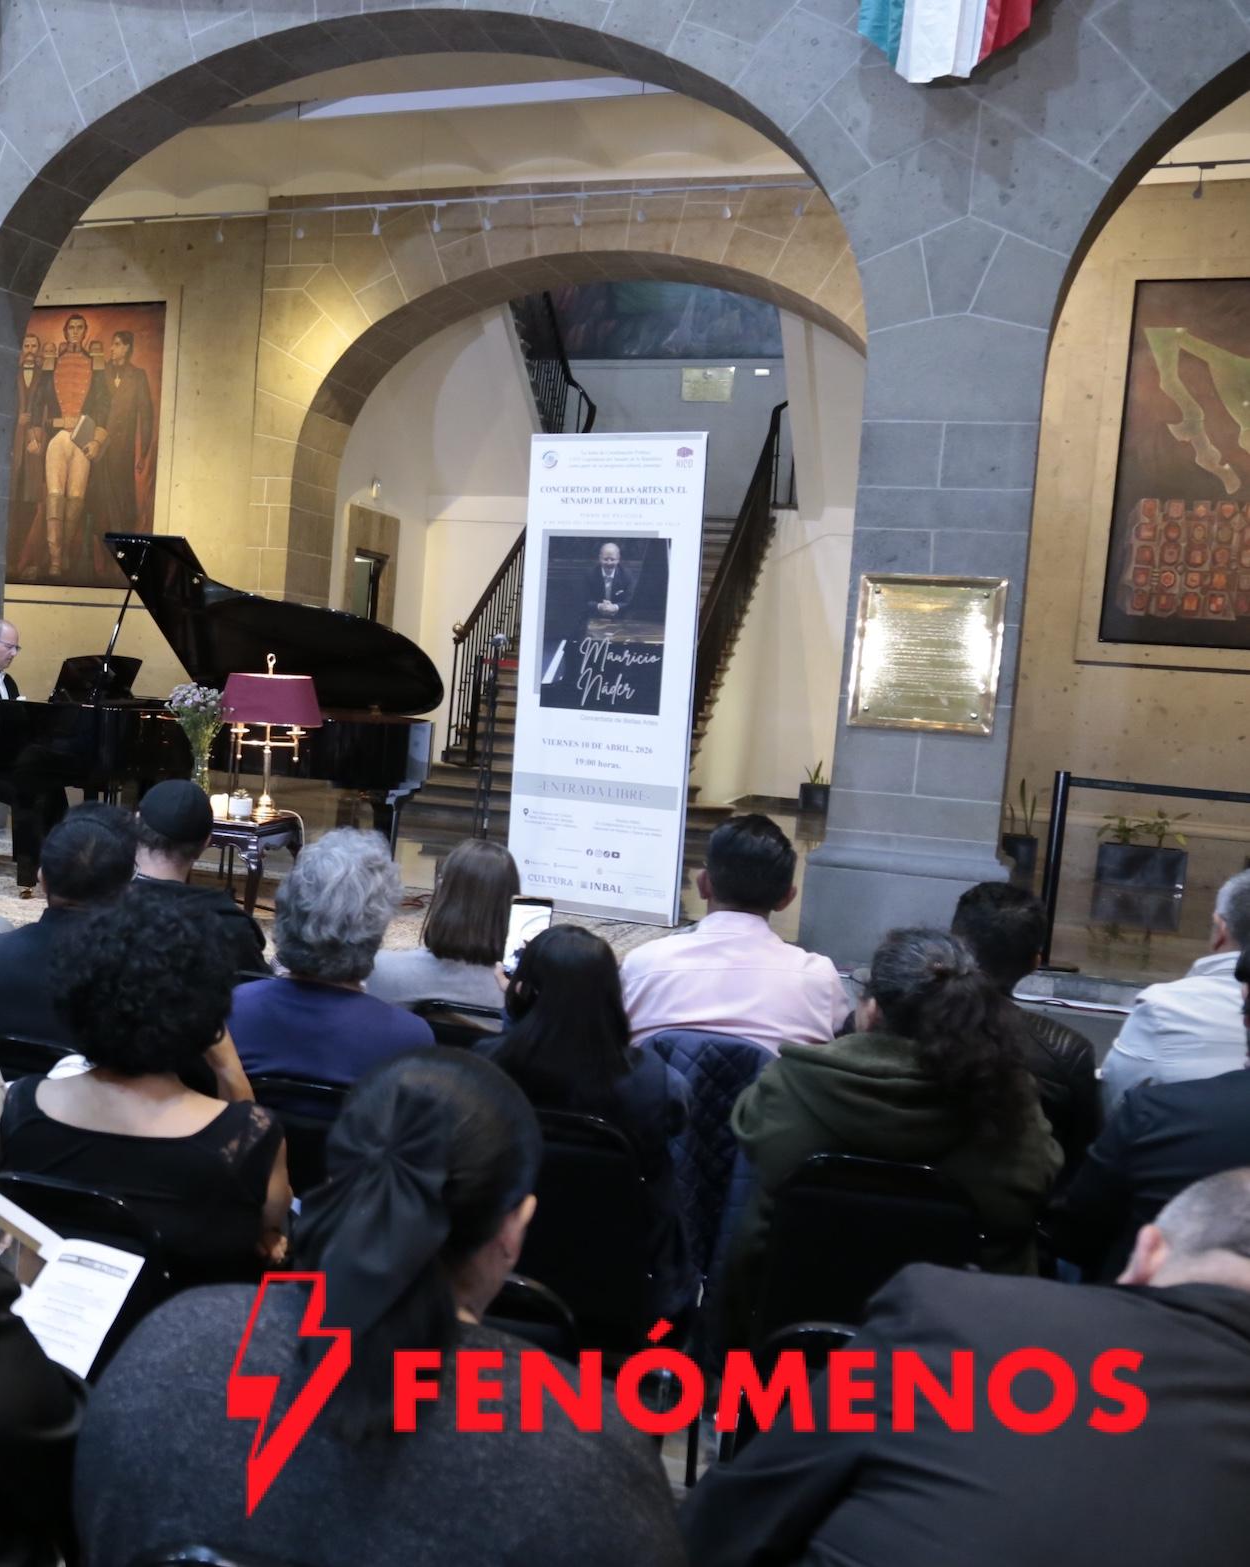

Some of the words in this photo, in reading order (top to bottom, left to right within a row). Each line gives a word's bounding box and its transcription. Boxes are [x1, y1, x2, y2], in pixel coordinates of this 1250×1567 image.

[540, 486, 591, 494] CONCIERTOS
[592, 486, 602, 494] DE
[604, 486, 635, 494] BELLAS
[637, 486, 663, 494] ARTES
[664, 486, 675, 494] EN
[677, 486, 688, 494] EL
[560, 497, 593, 505] SENADO
[594, 497, 603, 505] DE
[606, 497, 617, 505] LA
[618, 496, 665, 506] REPÚBLICA
[579, 637, 661, 674] Mauricio
[577, 668, 635, 706] Náder
[542, 738, 579, 748] VIERNES
[592, 742, 603, 750] DE
[635, 746, 653, 754] 2026
[575, 758, 596, 766] 19:00
[598, 760, 621, 769] horas.
[527, 873, 573, 887] CULTURA
[590, 882, 623, 894] INBAL
